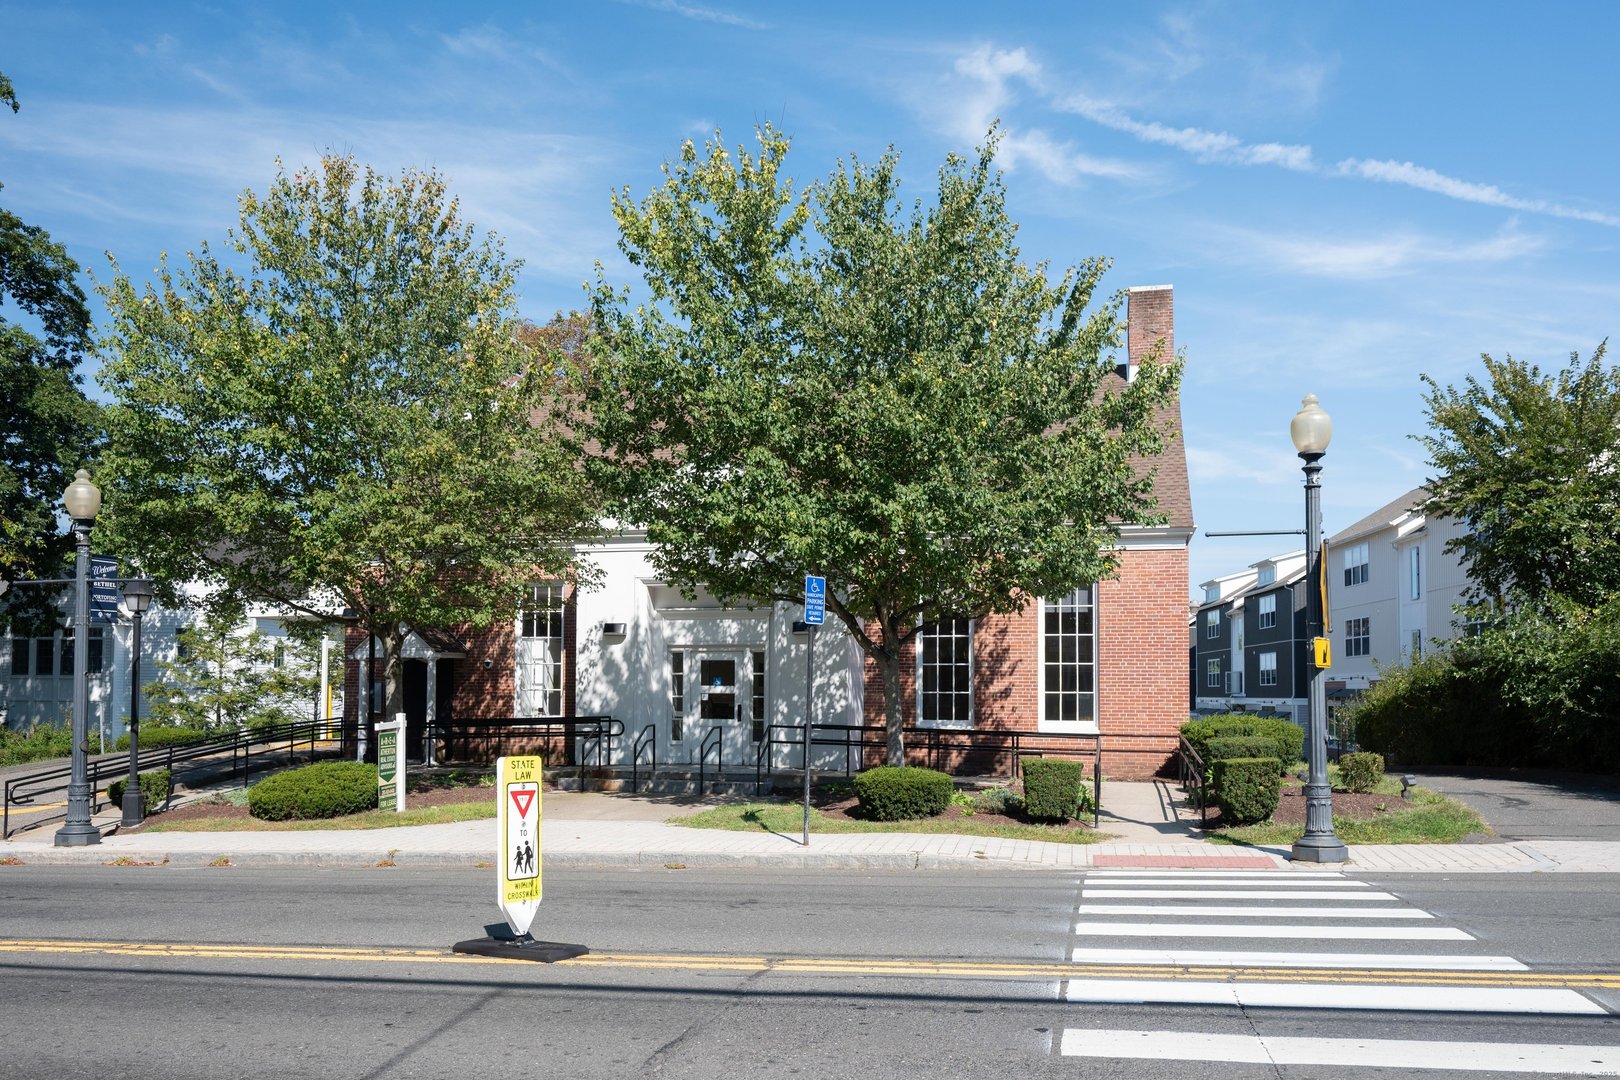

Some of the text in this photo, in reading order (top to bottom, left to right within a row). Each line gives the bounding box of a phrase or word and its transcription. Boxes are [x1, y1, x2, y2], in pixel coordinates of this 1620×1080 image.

[92, 565, 116, 575] Welcome
[511, 760, 535, 769] STATE
[515, 771, 531, 780] LAW
[514, 880, 534, 890] WITHIN
[507, 888, 539, 900] CROSSWALK
